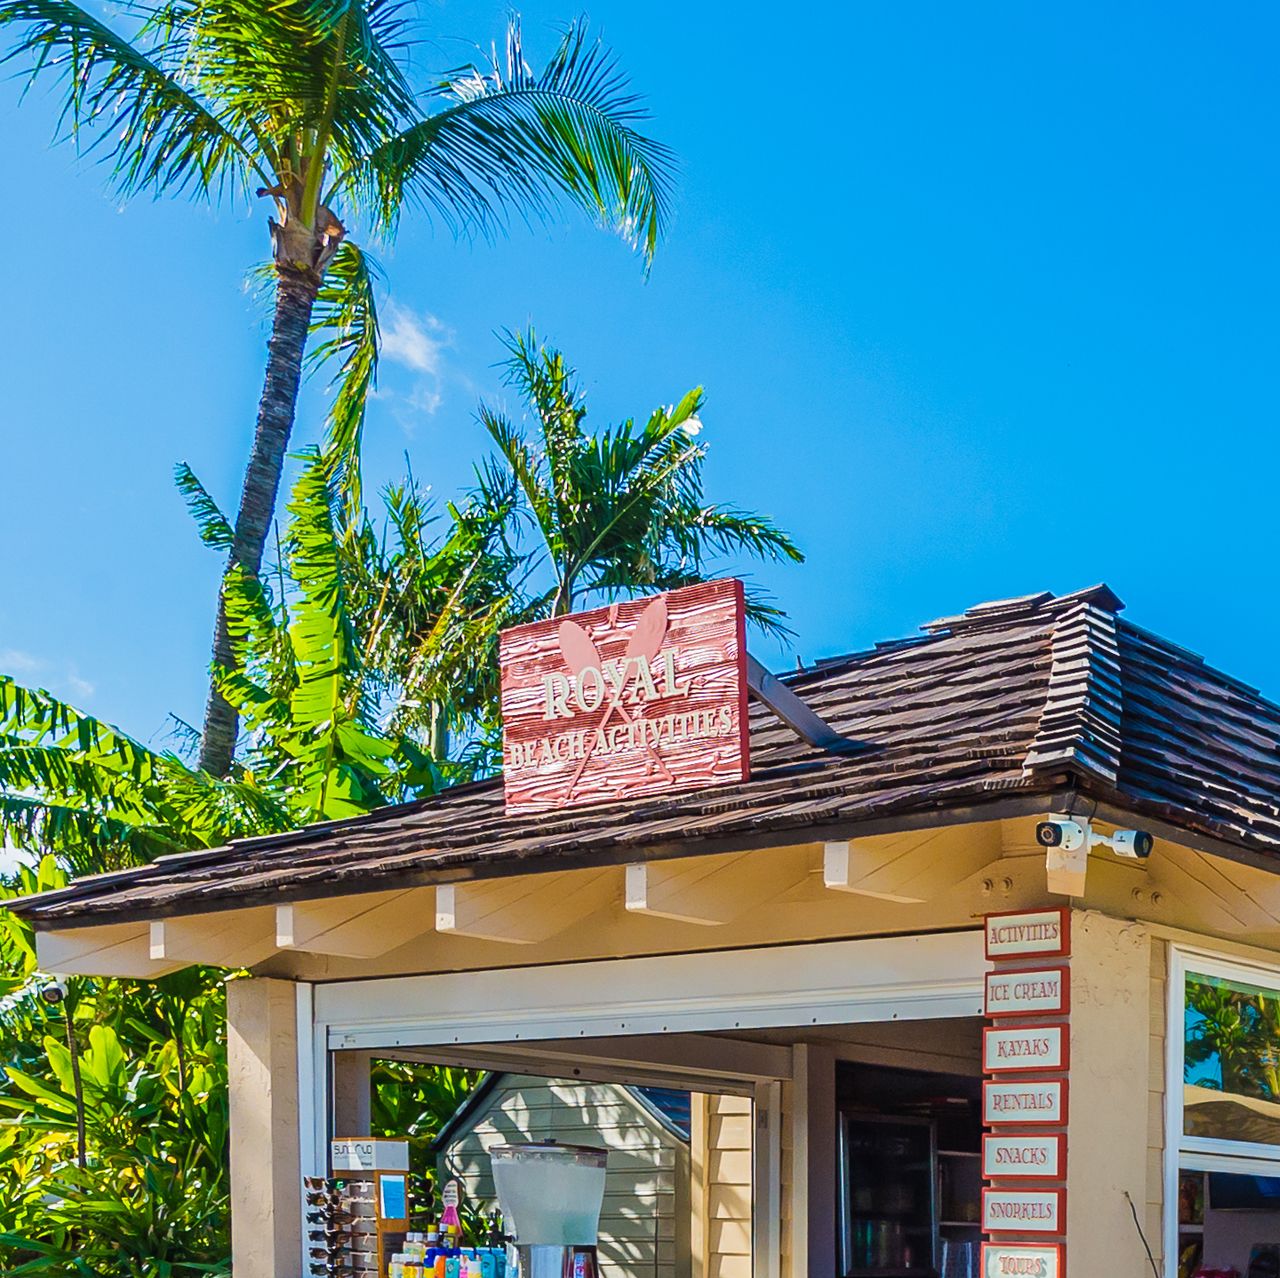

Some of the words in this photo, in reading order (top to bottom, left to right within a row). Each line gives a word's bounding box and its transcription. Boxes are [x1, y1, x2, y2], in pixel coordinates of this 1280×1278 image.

[542, 649, 689, 720] ROYAL
[509, 732, 587, 769] BEACH
[595, 705, 733, 752] ACTIVITIES
[989, 922, 1059, 945] ACTIVITIES
[990, 983, 1010, 1001] ICE
[1014, 981, 1058, 1001] CREAM
[997, 1038, 1050, 1058] KAYAKS
[993, 1093, 1053, 1112] RENTALS
[995, 1147, 1047, 1165] SNACKS
[990, 1202, 1052, 1220] SNORKELS
[999, 1255, 1042, 1275] TOURS
